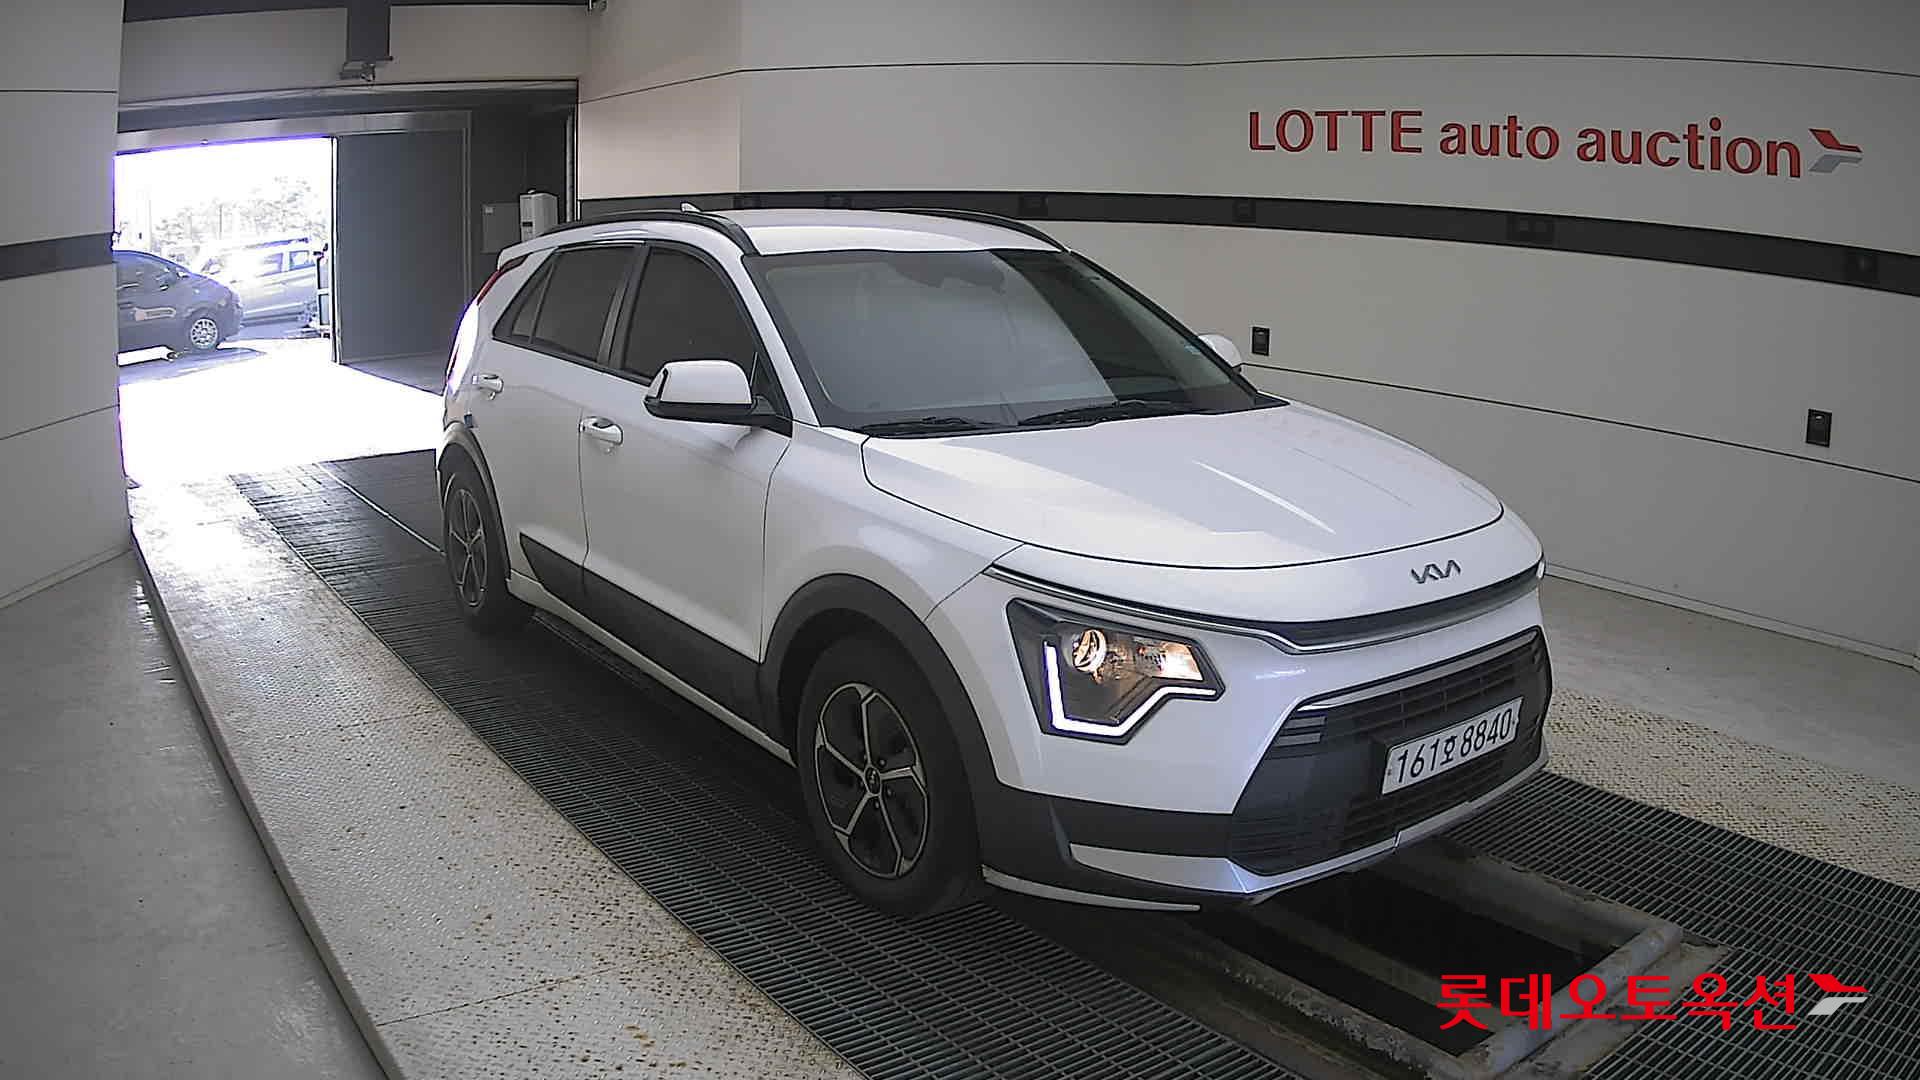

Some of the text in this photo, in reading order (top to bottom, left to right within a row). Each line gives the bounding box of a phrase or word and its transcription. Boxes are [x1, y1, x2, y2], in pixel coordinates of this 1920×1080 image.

[1248, 110, 1801, 178] LOTTE auto auction
